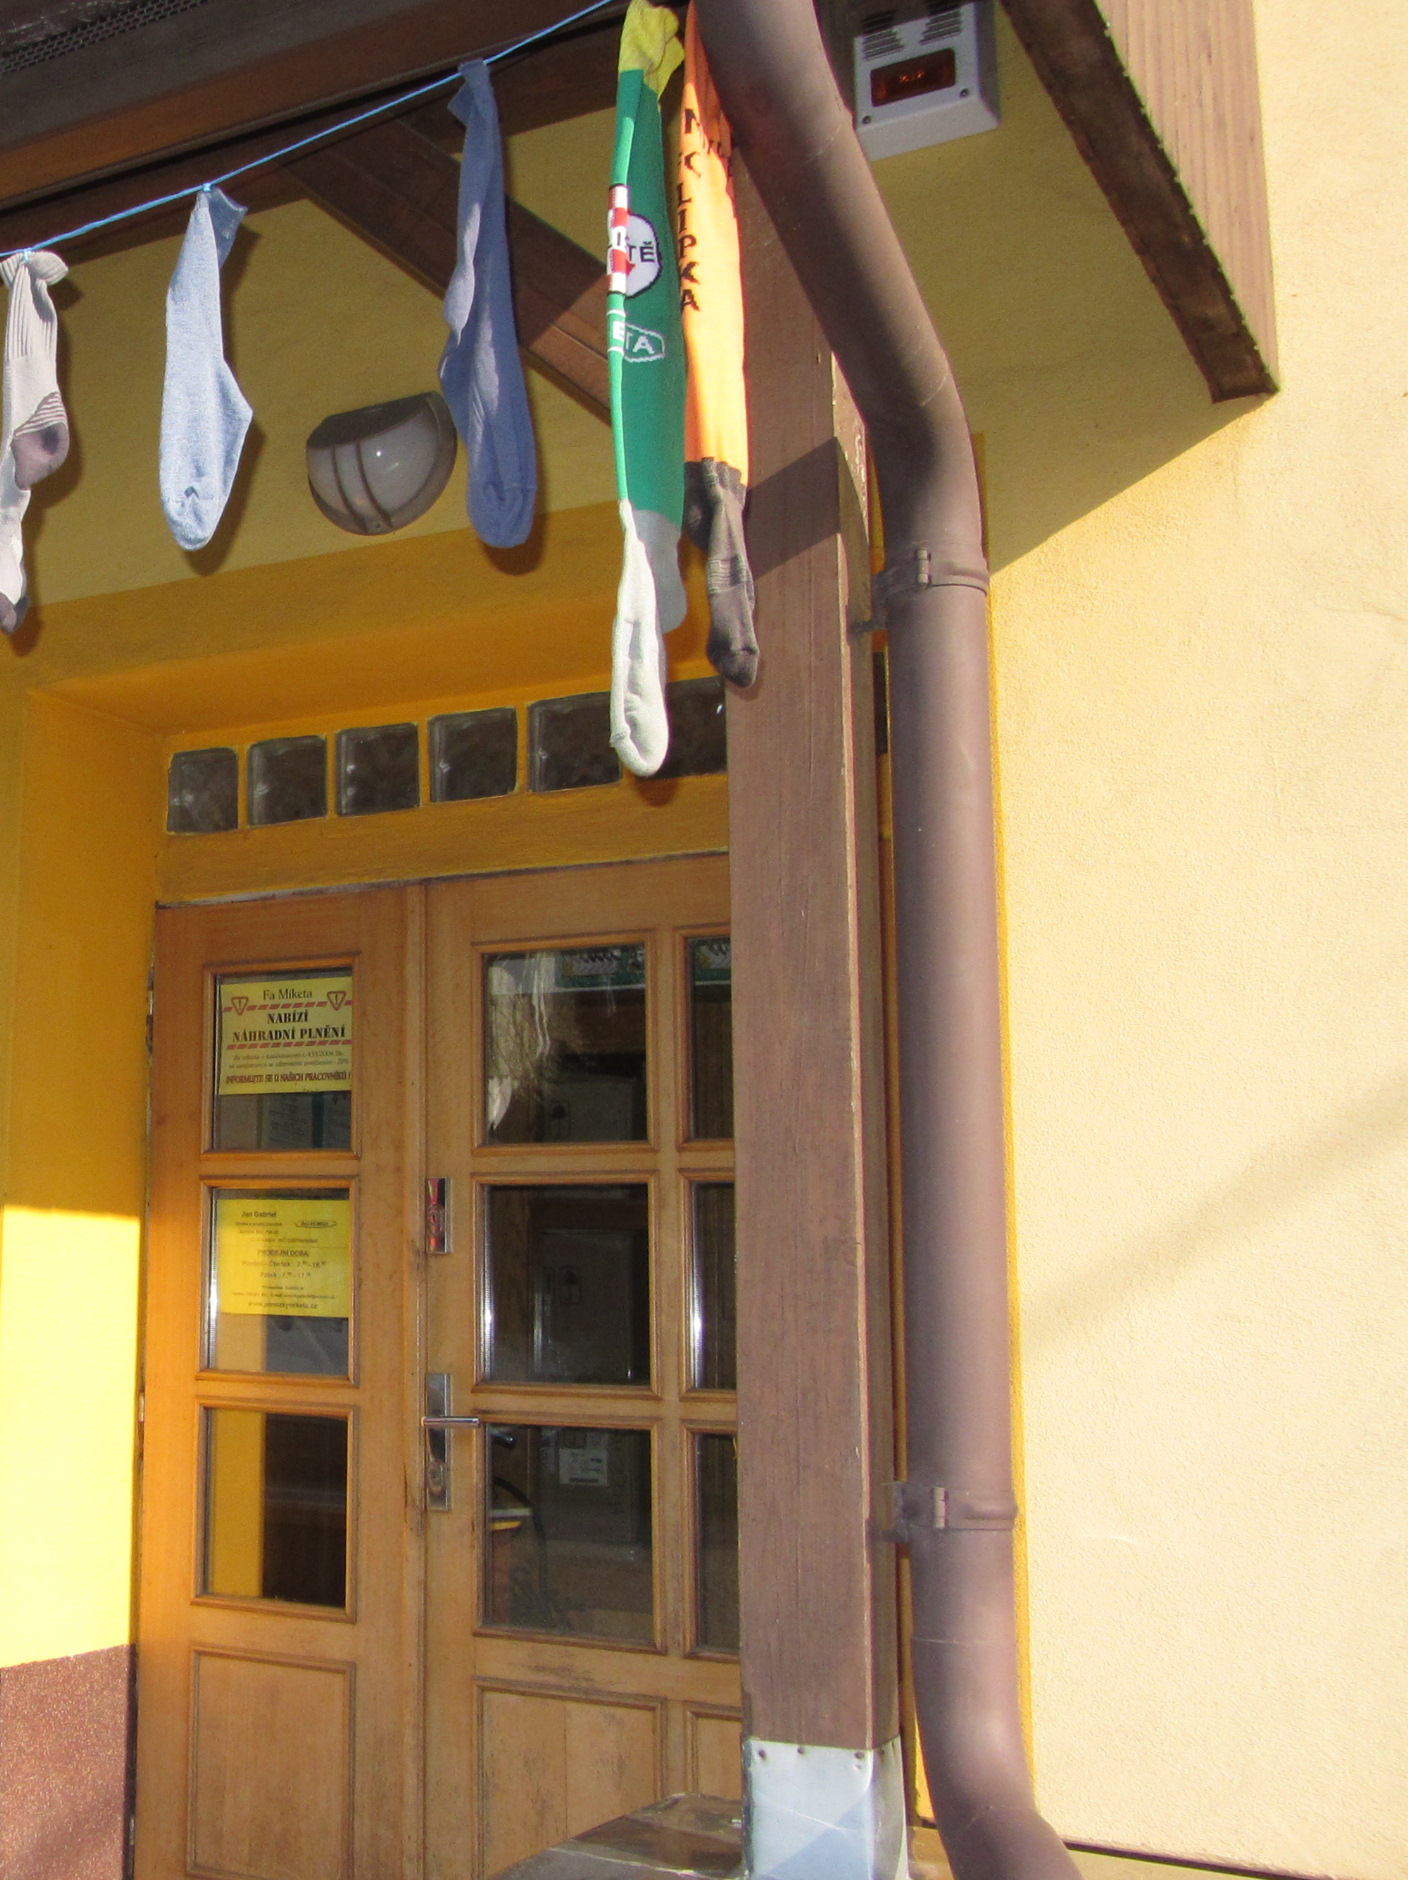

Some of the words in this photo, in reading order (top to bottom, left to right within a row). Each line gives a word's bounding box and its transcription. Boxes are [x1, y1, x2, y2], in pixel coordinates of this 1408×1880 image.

[263, 989, 276, 1001] Fa
[278, 988, 313, 1000] Miketa
[266, 1009, 309, 1025] NABÍZÍ
[232, 1026, 296, 1043] NÁHRADNÍ
[299, 1024, 346, 1039] PLNĚNÍ
